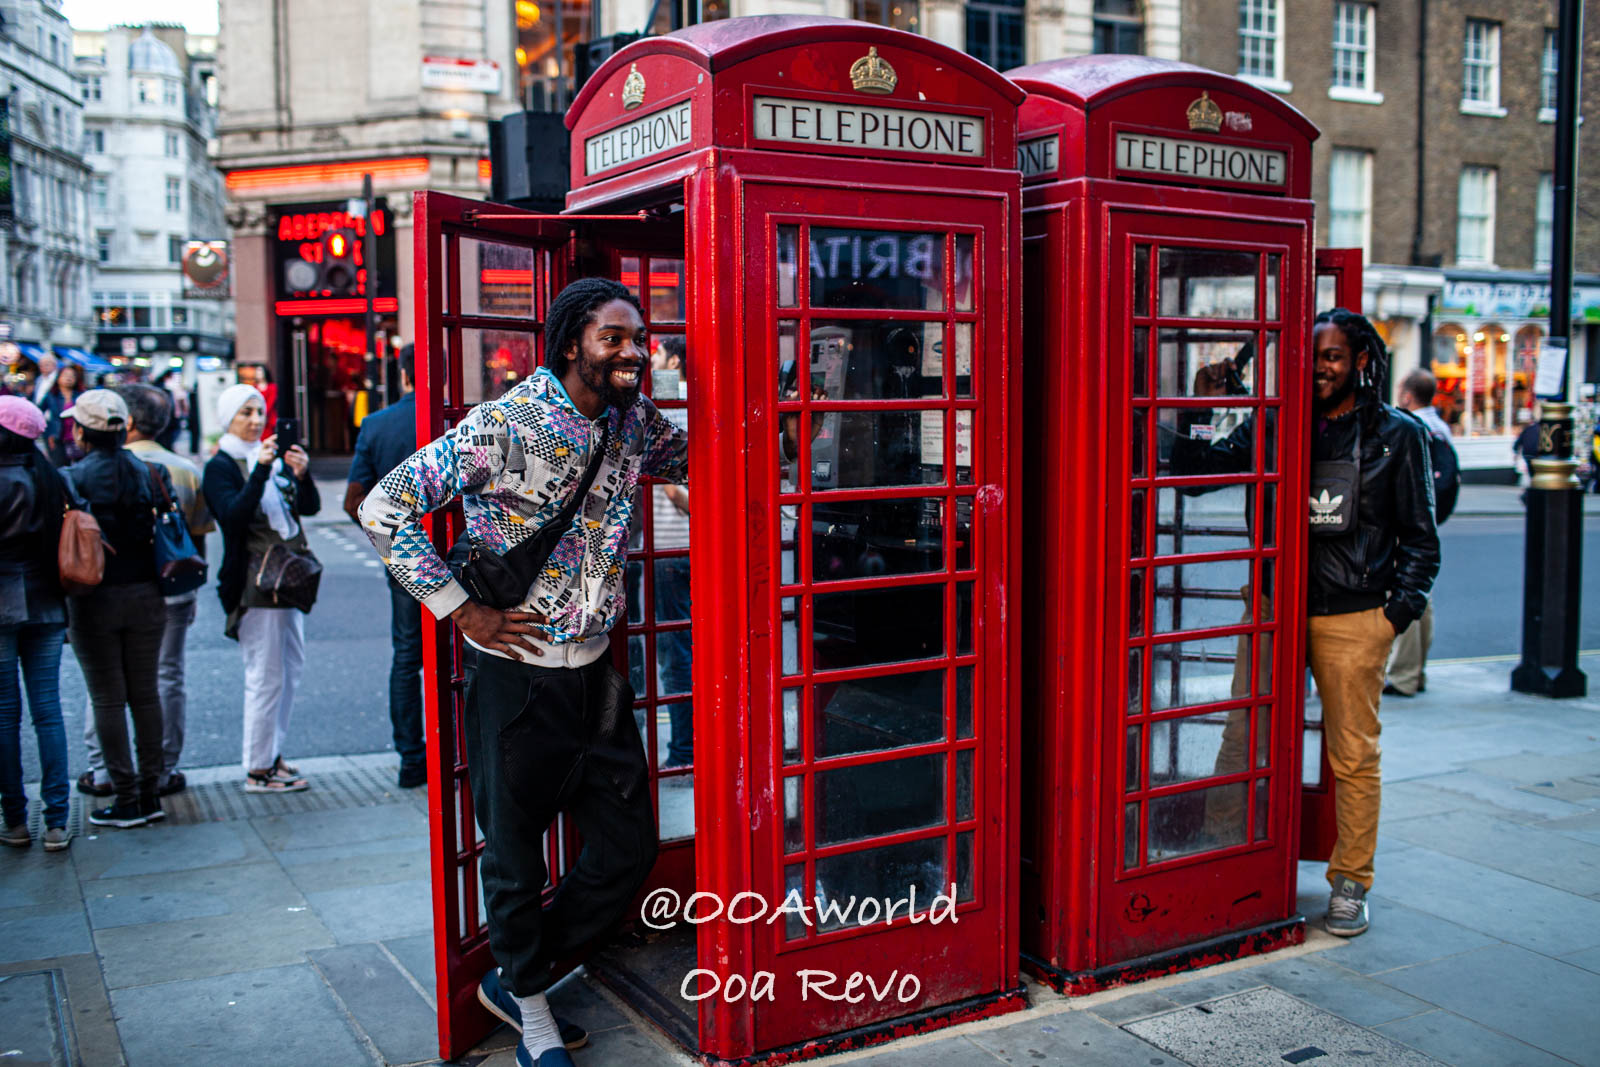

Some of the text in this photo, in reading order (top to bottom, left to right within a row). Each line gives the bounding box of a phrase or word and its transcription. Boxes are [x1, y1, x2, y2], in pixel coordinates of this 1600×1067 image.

[590, 107, 690, 171] TELEPHONE
[761, 103, 976, 154] TELEPHONE
[1120, 137, 1279, 184] TELEPHONE
